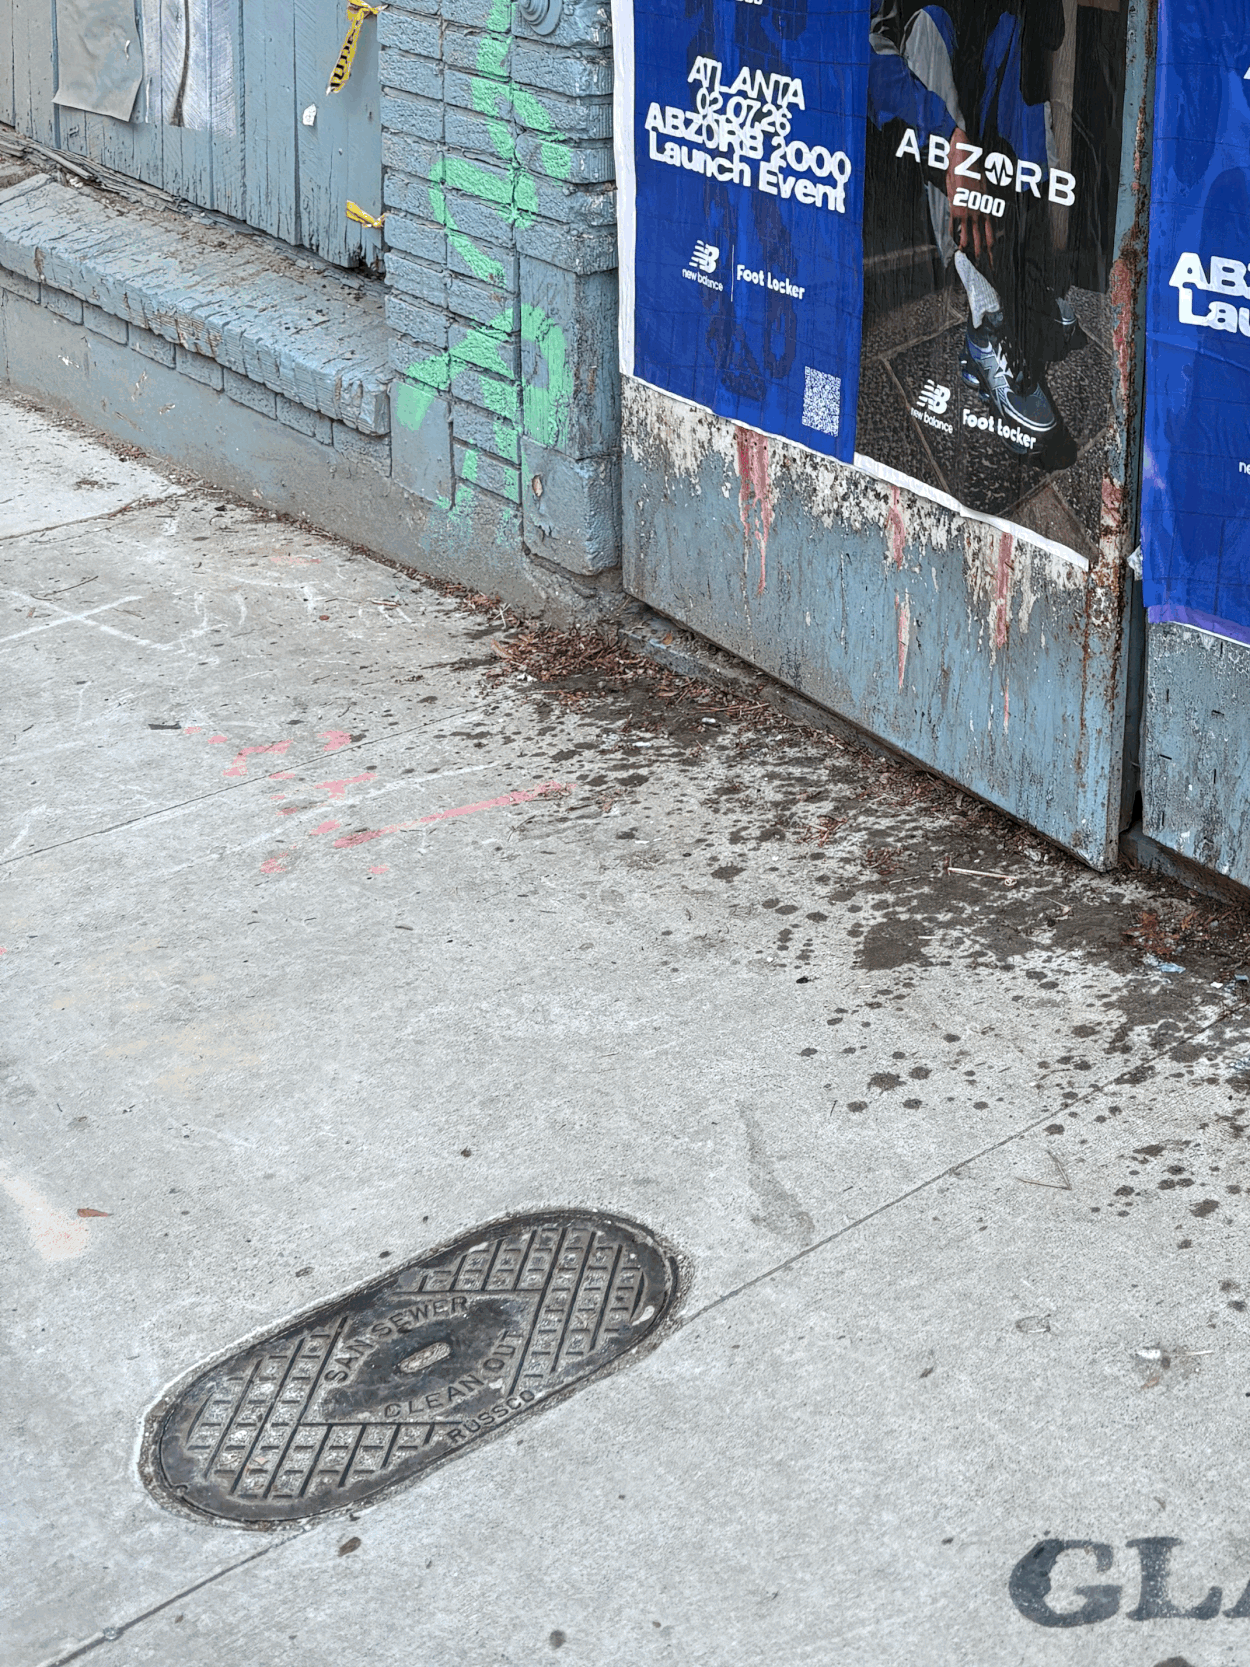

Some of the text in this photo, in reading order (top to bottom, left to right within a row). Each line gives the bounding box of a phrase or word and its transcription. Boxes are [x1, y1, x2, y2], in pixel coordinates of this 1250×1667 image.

[687, 55, 806, 110] ATLANTA
[645, 102, 852, 183] ABZORB 2000
[895, 128, 1077, 207] ABZORB
[649, 131, 845, 213] Launch Event
[952, 186, 1006, 218] 2000
[682, 268, 698, 281] new
[736, 264, 805, 300] Foot Locker
[910, 407, 954, 434] new balance
[962, 409, 1037, 449] Foot Locker
[324, 1296, 468, 1384] SAN SEWER
[384, 1330, 524, 1418] CLEAN OUT
[447, 1389, 536, 1443] RUSSCO
